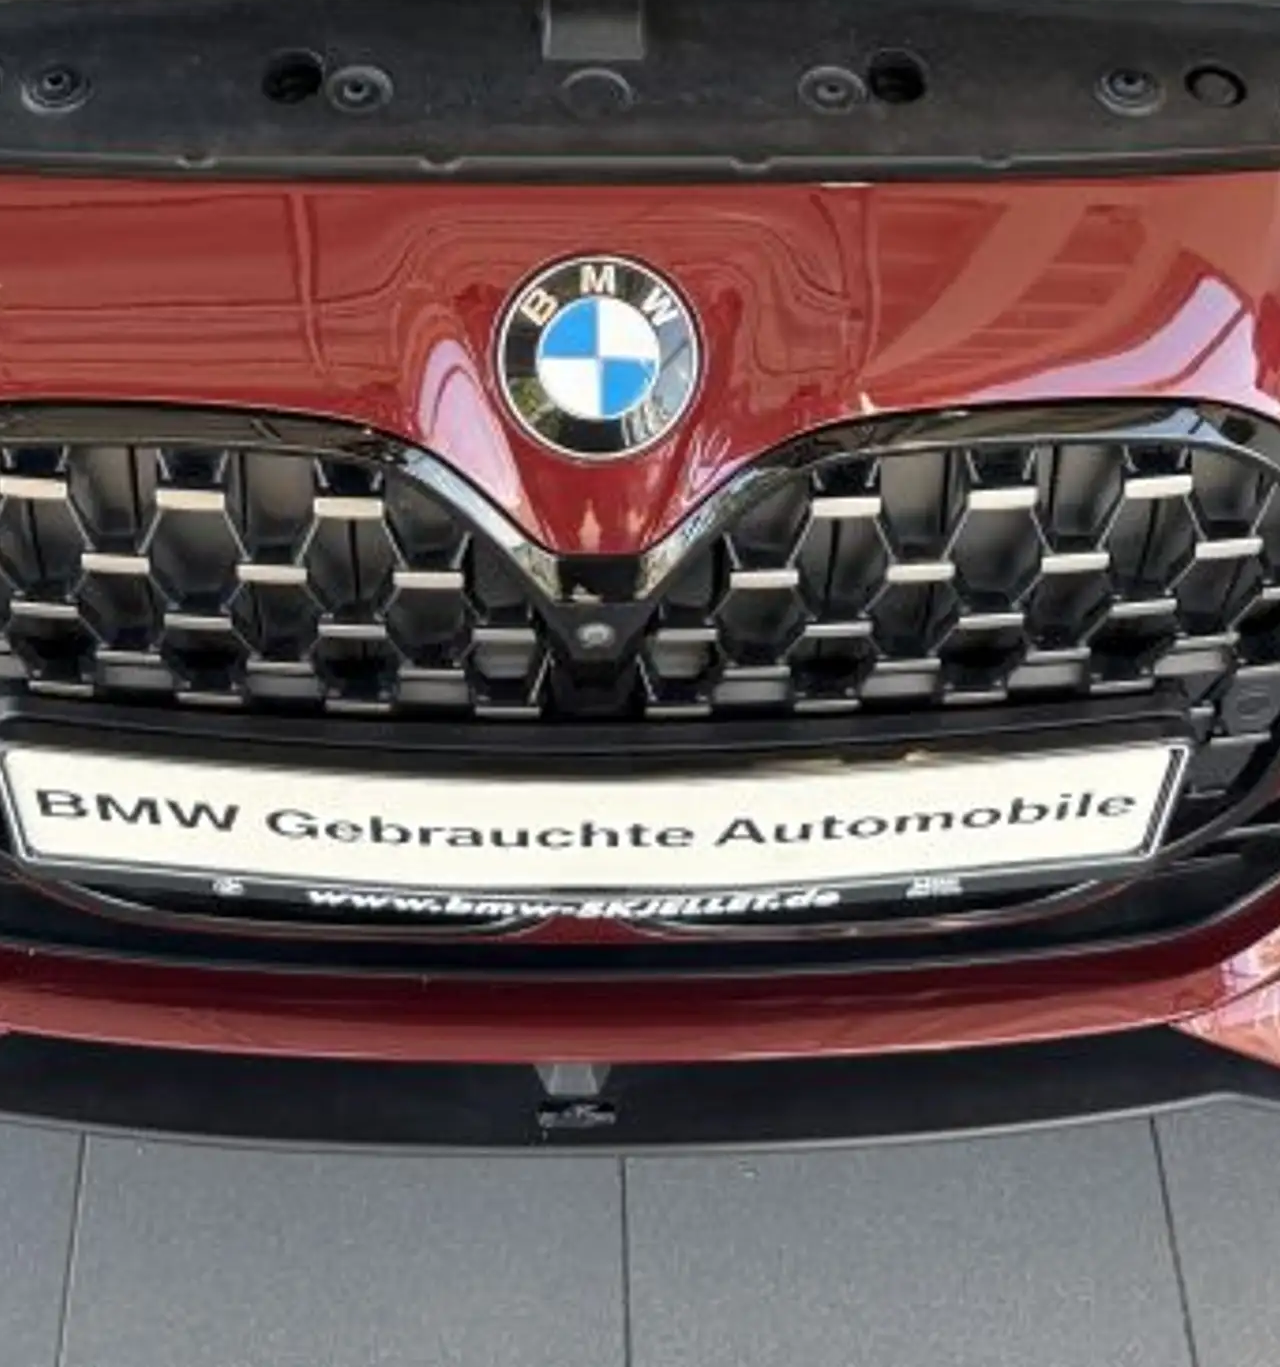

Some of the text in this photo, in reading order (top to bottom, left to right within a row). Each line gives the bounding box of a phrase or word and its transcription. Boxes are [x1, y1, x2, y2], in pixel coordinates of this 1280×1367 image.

[519, 264, 678, 327] BMW
[35, 787, 1137, 851] BMW Gebrauchte Automobile
